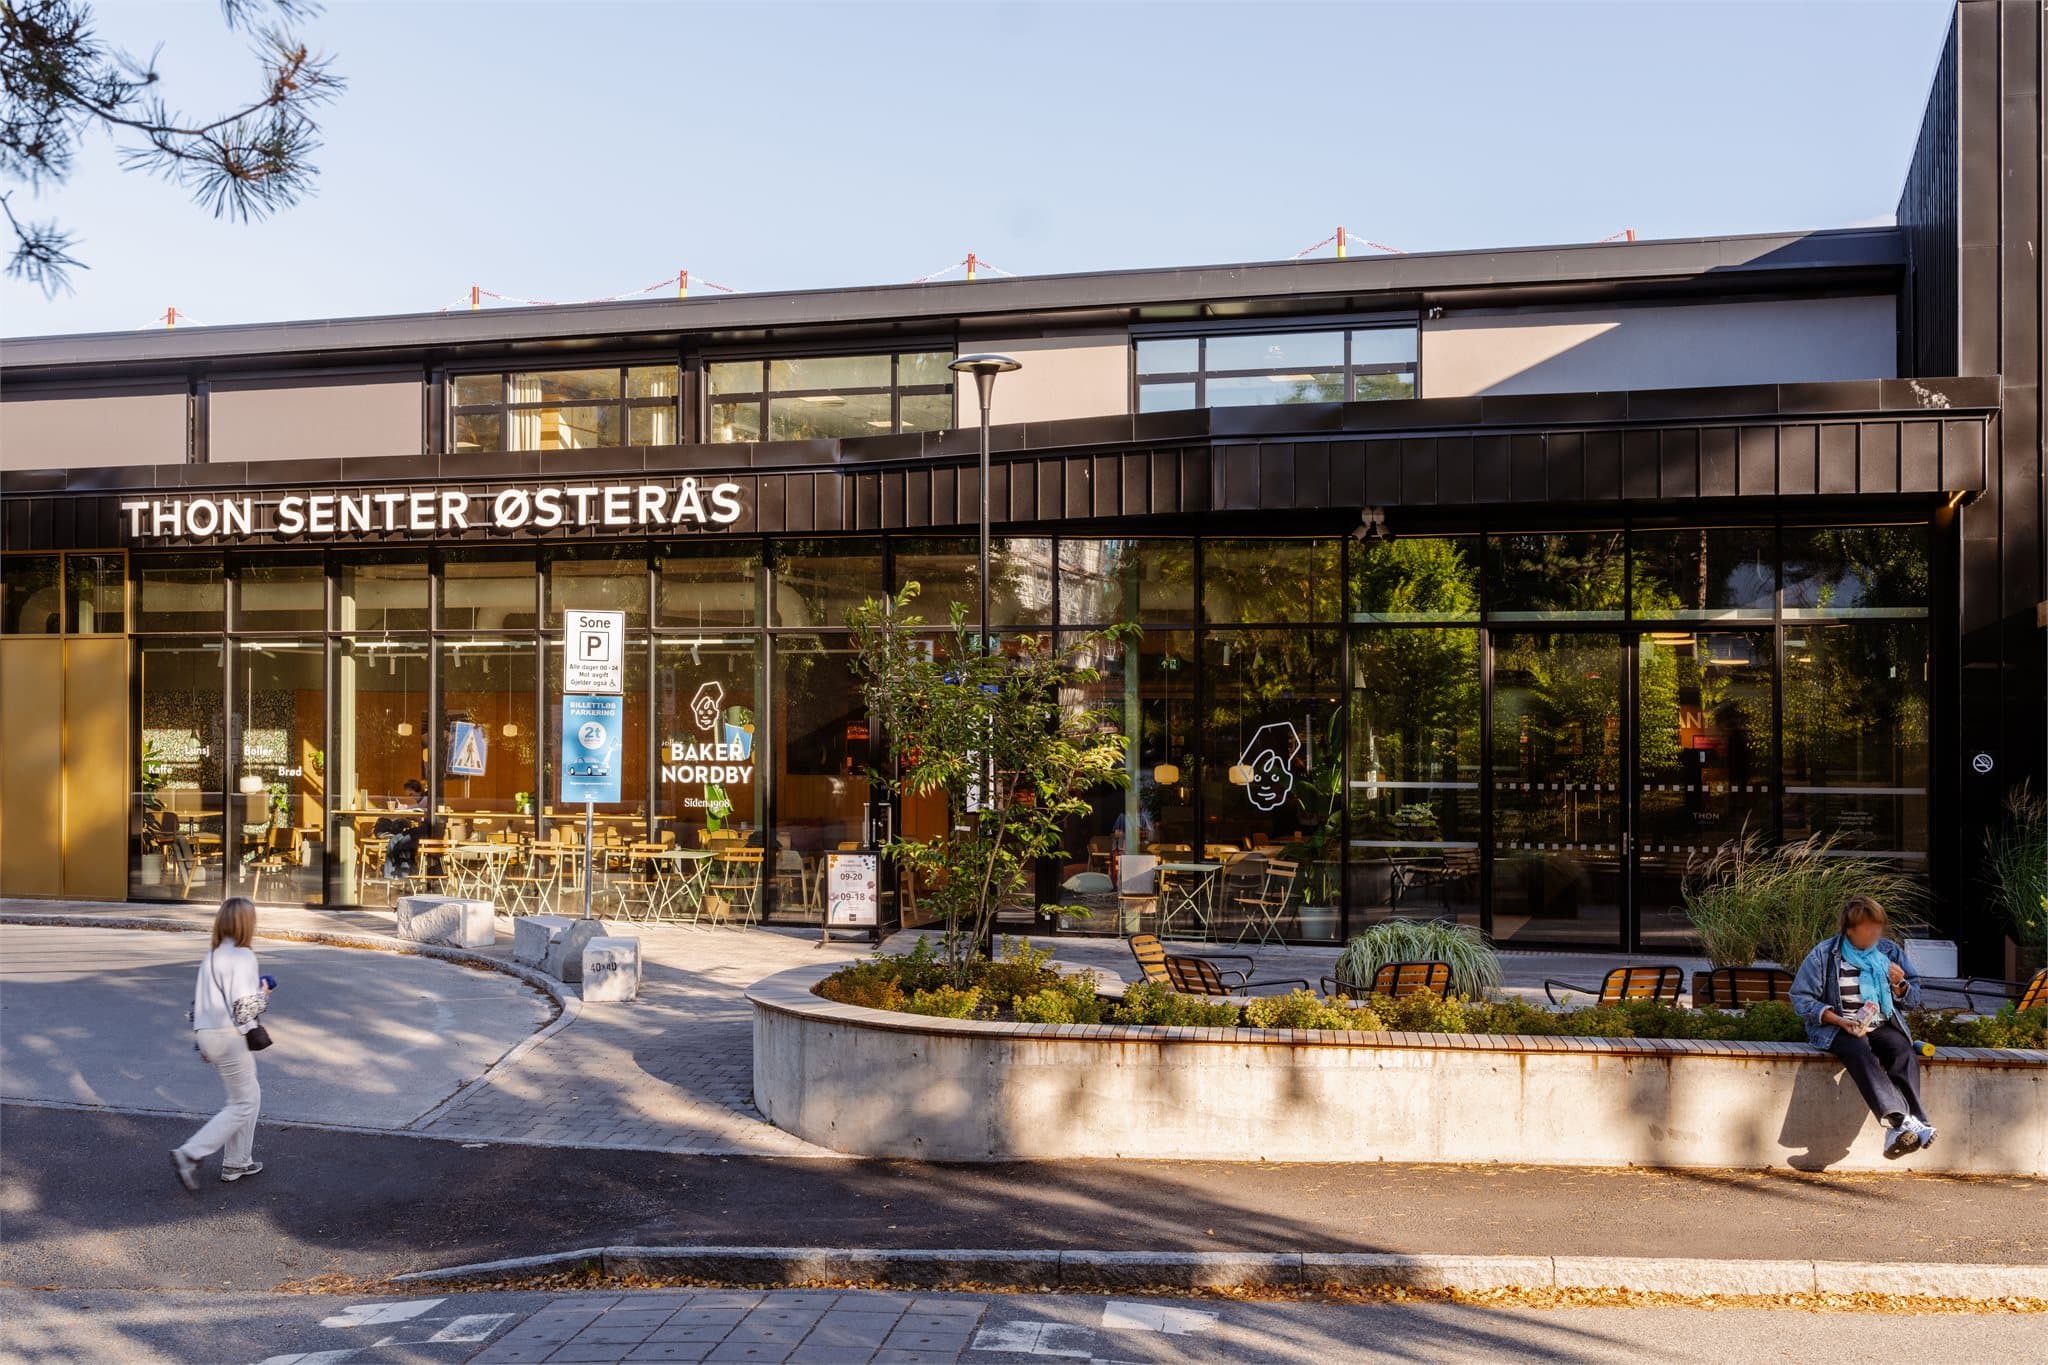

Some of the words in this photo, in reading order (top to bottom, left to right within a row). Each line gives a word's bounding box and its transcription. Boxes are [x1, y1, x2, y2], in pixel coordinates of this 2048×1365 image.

[121, 498, 251, 537] THON
[278, 491, 470, 534] SENTER
[494, 477, 741, 528] ØSTERÅS
[579, 616, 611, 628] Sone
[587, 636, 602, 656] P
[570, 679, 591, 687] Gjelder
[570, 709, 615, 717] PARKERING
[185, 746, 210, 757] Lunsj
[671, 743, 744, 761] BAKER
[148, 765, 173, 774] Kaffe
[278, 766, 302, 776] Brød
[661, 765, 753, 784] NORDBY
[684, 798, 707, 808] Siden
[709, 799, 730, 808] 1908
[1693, 812, 1720, 820] THON
[840, 873, 863, 881] 09-20
[840, 892, 865, 901] 09-18
